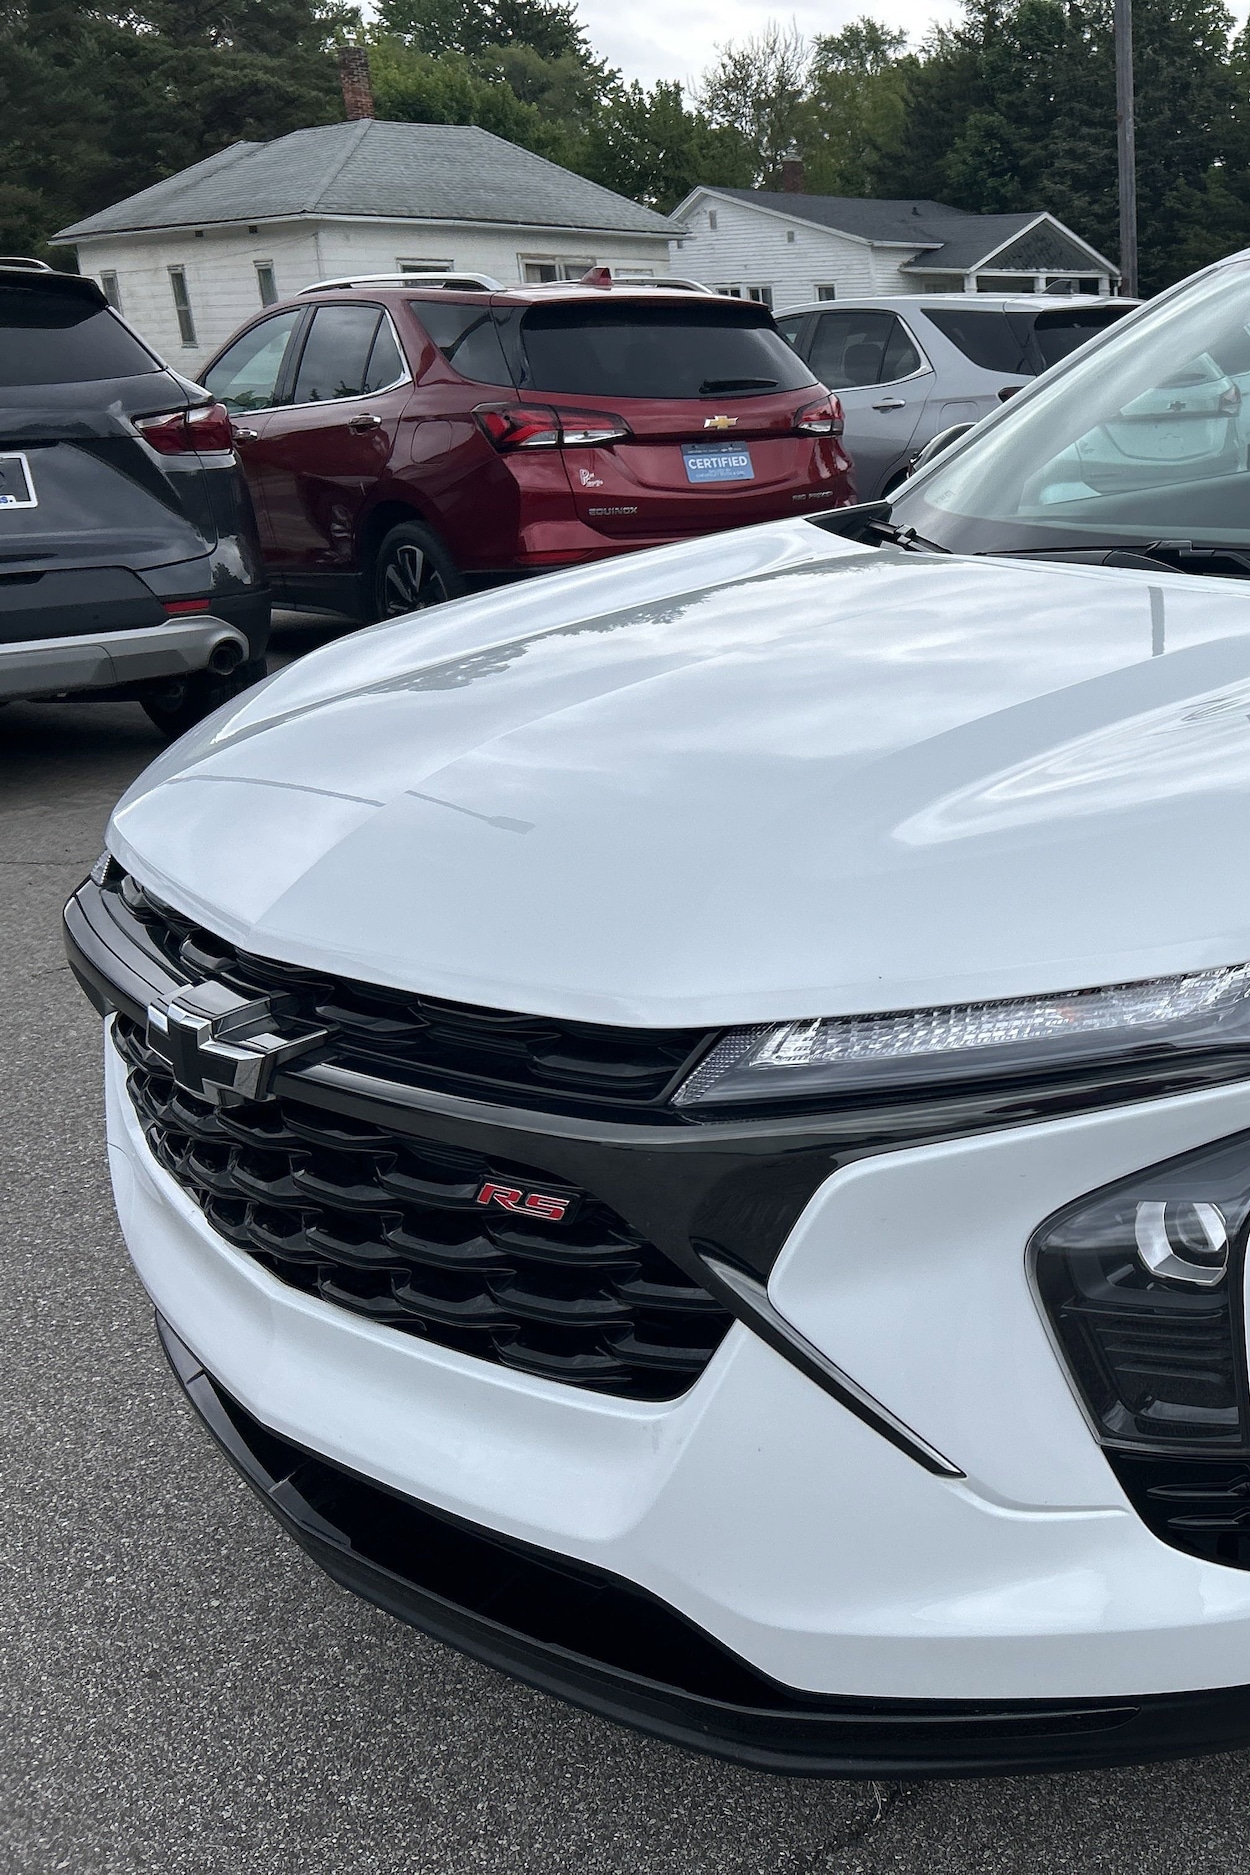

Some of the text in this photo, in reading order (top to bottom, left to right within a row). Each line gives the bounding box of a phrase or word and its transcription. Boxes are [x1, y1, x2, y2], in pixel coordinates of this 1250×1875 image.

[688, 455, 748, 470] CERTIFIED
[588, 506, 638, 516] EQUINOX
[476, 1182, 570, 1221] RS
